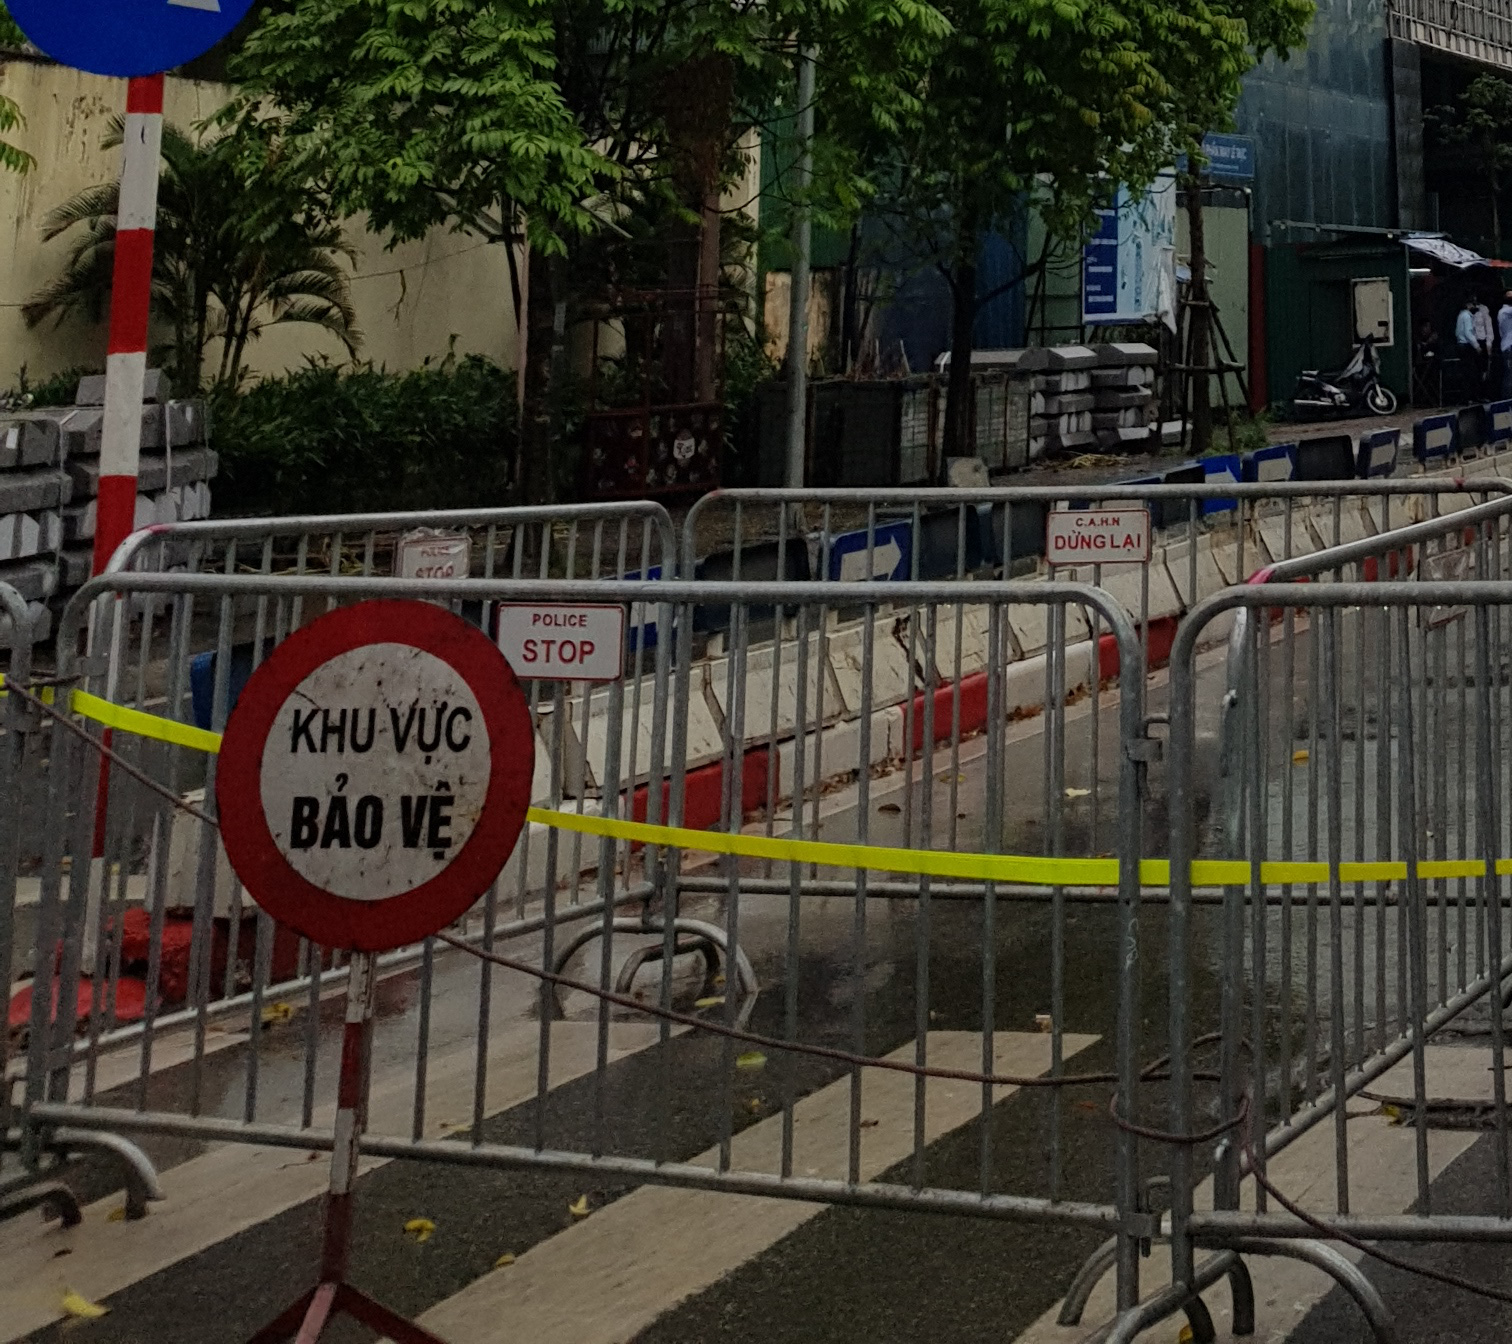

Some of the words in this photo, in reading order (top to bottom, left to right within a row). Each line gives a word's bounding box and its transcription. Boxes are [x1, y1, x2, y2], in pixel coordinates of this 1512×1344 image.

[1075, 516, 1120, 527] C.A.H.N
[1054, 529, 1106, 550] DỪNG
[1110, 533, 1141, 552] LẠI
[532, 613, 588, 628] POLICE
[522, 638, 596, 665] STOP
[290, 708, 376, 754] KHU
[390, 701, 473, 765] VỰC
[290, 772, 384, 850] BẢO
[400, 780, 455, 861] VỆ
